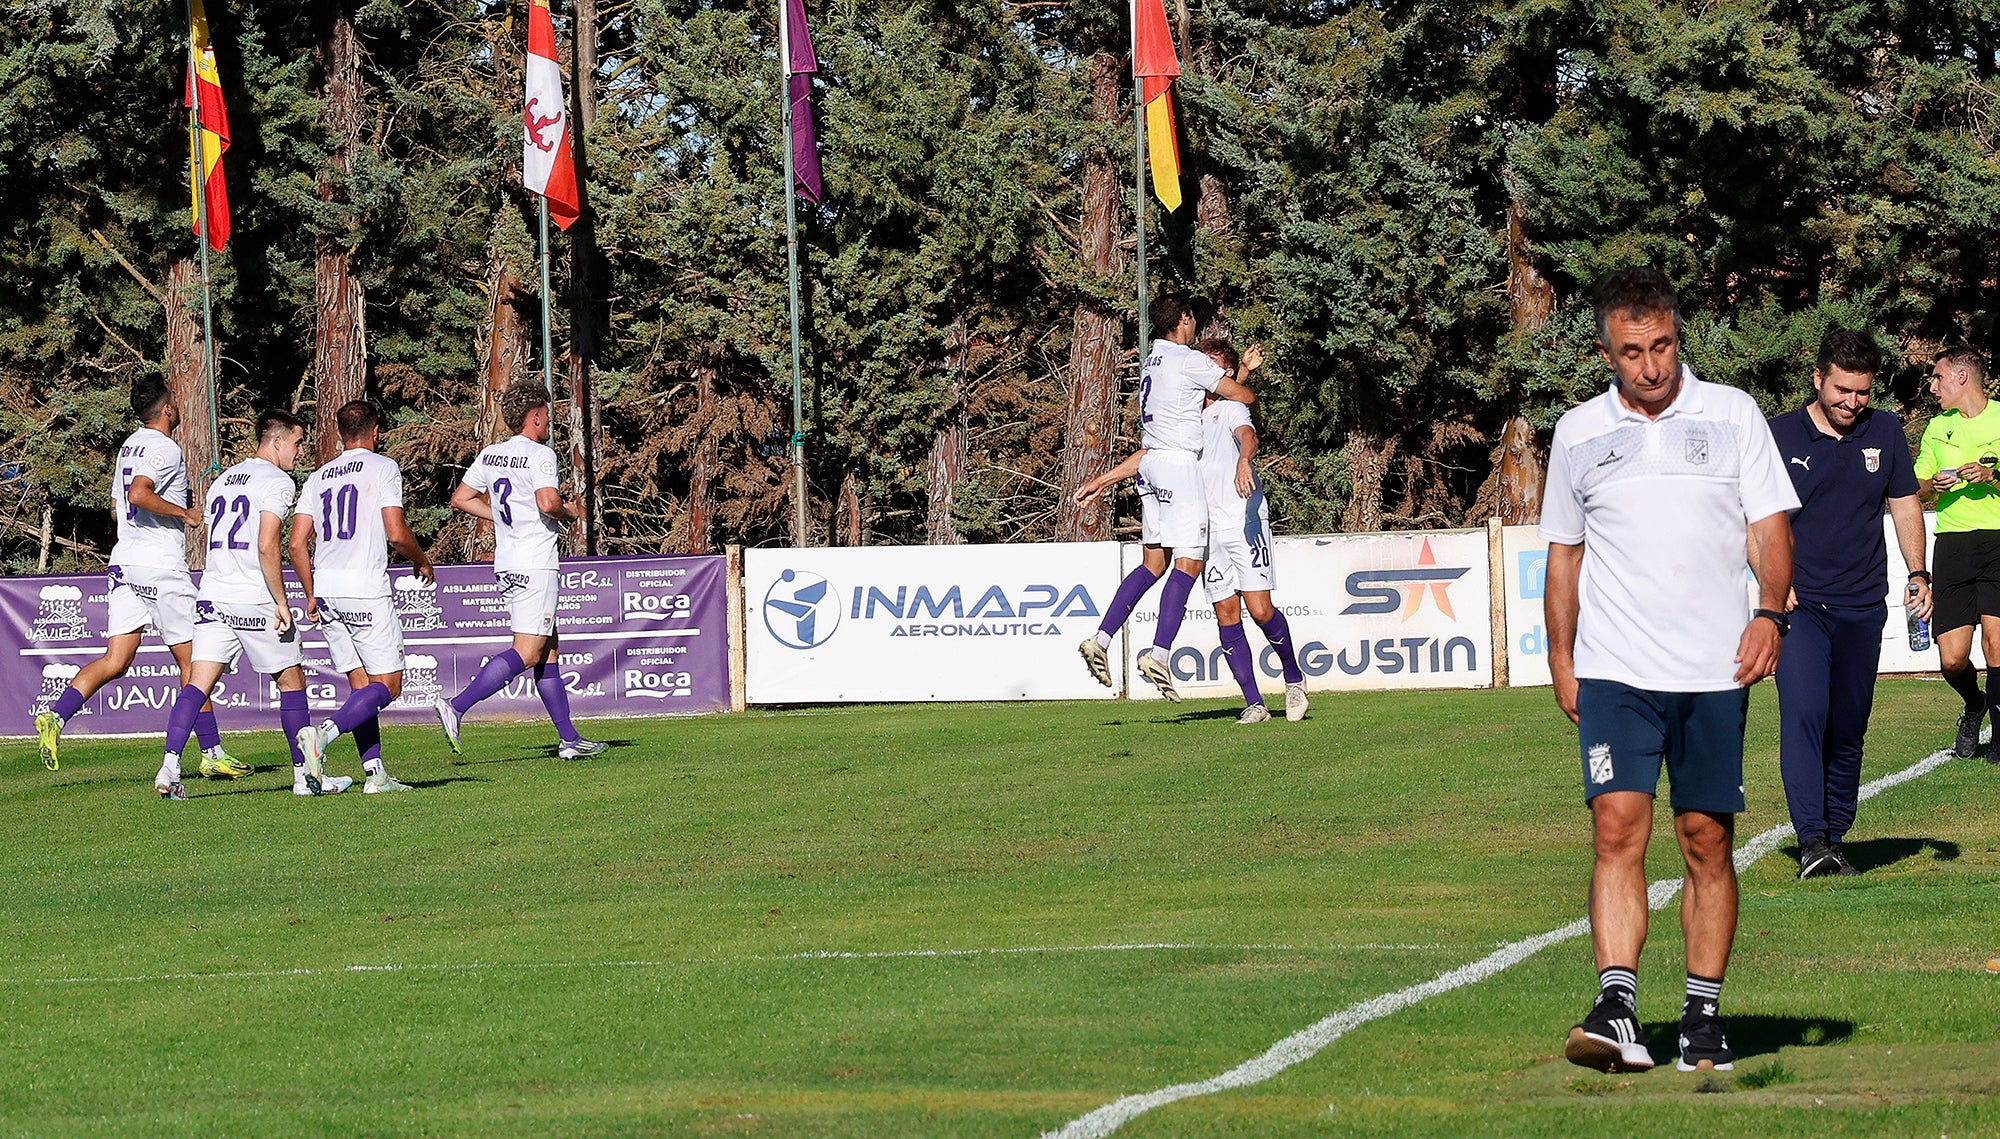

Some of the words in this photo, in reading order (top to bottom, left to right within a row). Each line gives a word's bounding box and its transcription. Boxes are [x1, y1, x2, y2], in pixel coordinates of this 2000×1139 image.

[1140, 374, 1153, 424] 2
[224, 474, 251, 486] SAMU
[493, 477, 513, 527] 3
[209, 494, 251, 550] 22
[320, 483, 359, 542] 10
[1250, 546, 1270, 569] 20
[625, 568, 686, 578] DISTRIBUIDOR
[639, 579, 673, 588] OFICIAL
[556, 602, 581, 610] AÑOS
[623, 591, 691, 611] Roca
[850, 584, 1101, 619] INMAPA
[890, 622, 1062, 637] AERONÁUTICA
[626, 646, 687, 656] DISTRIBUIDOR
[640, 657, 674, 666] OFICIAL
[624, 669, 692, 689] Roca
